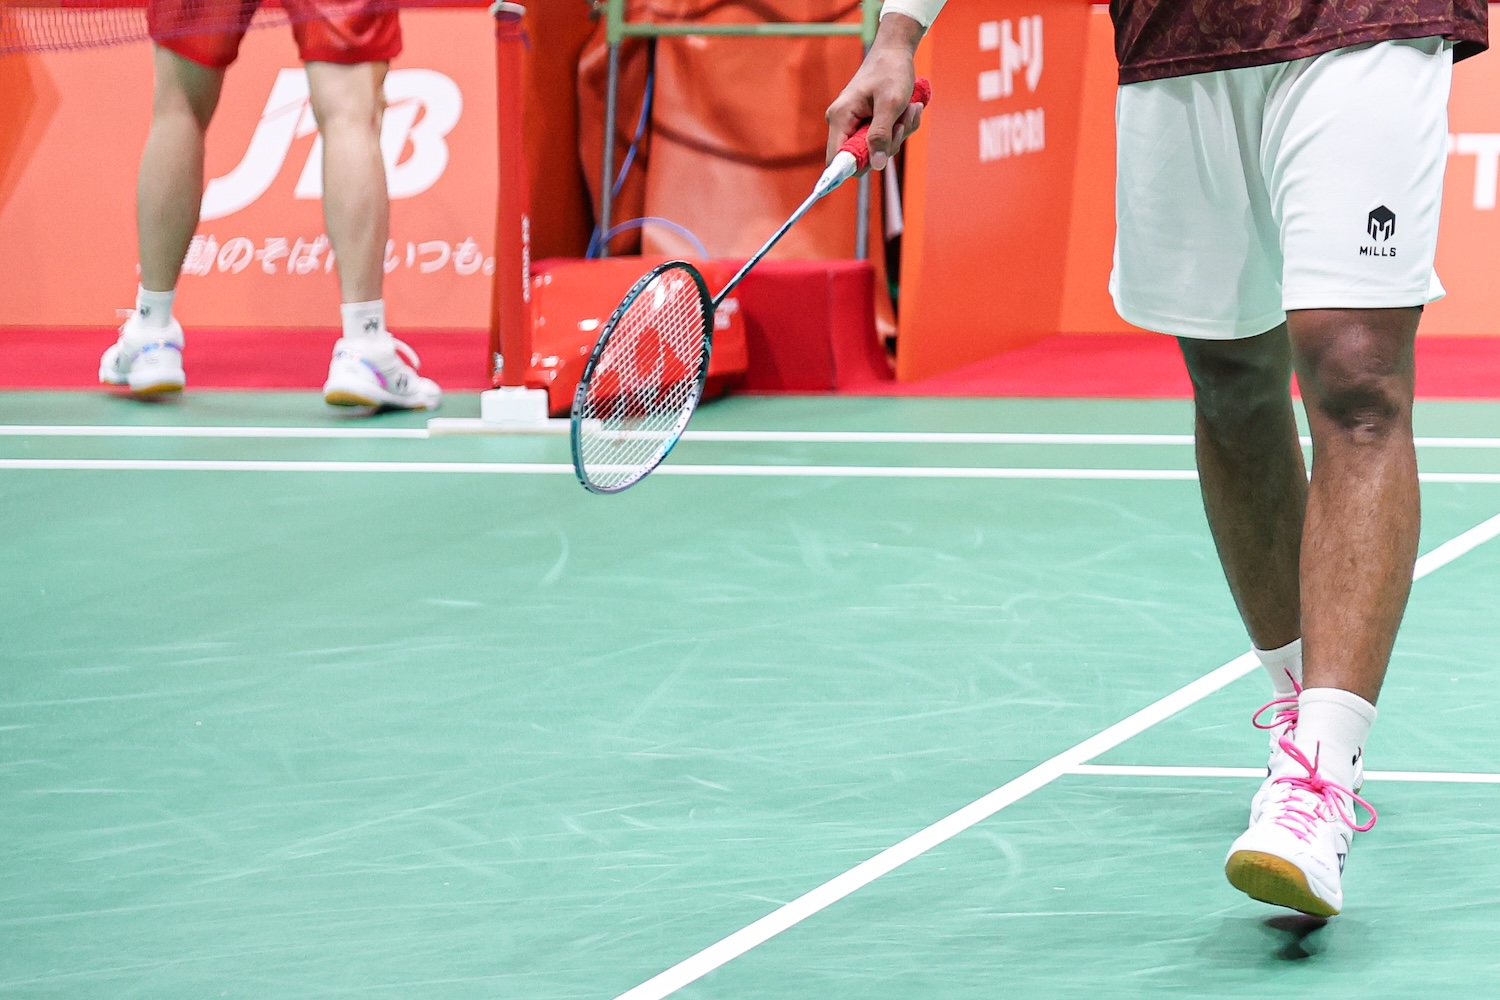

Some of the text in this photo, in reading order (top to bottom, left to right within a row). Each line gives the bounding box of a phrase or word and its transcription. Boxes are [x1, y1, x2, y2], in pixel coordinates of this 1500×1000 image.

[978, 14, 1043, 101] ニトリ
[979, 107, 1045, 162] NITORI
[1359, 245, 1397, 257] MILLS
